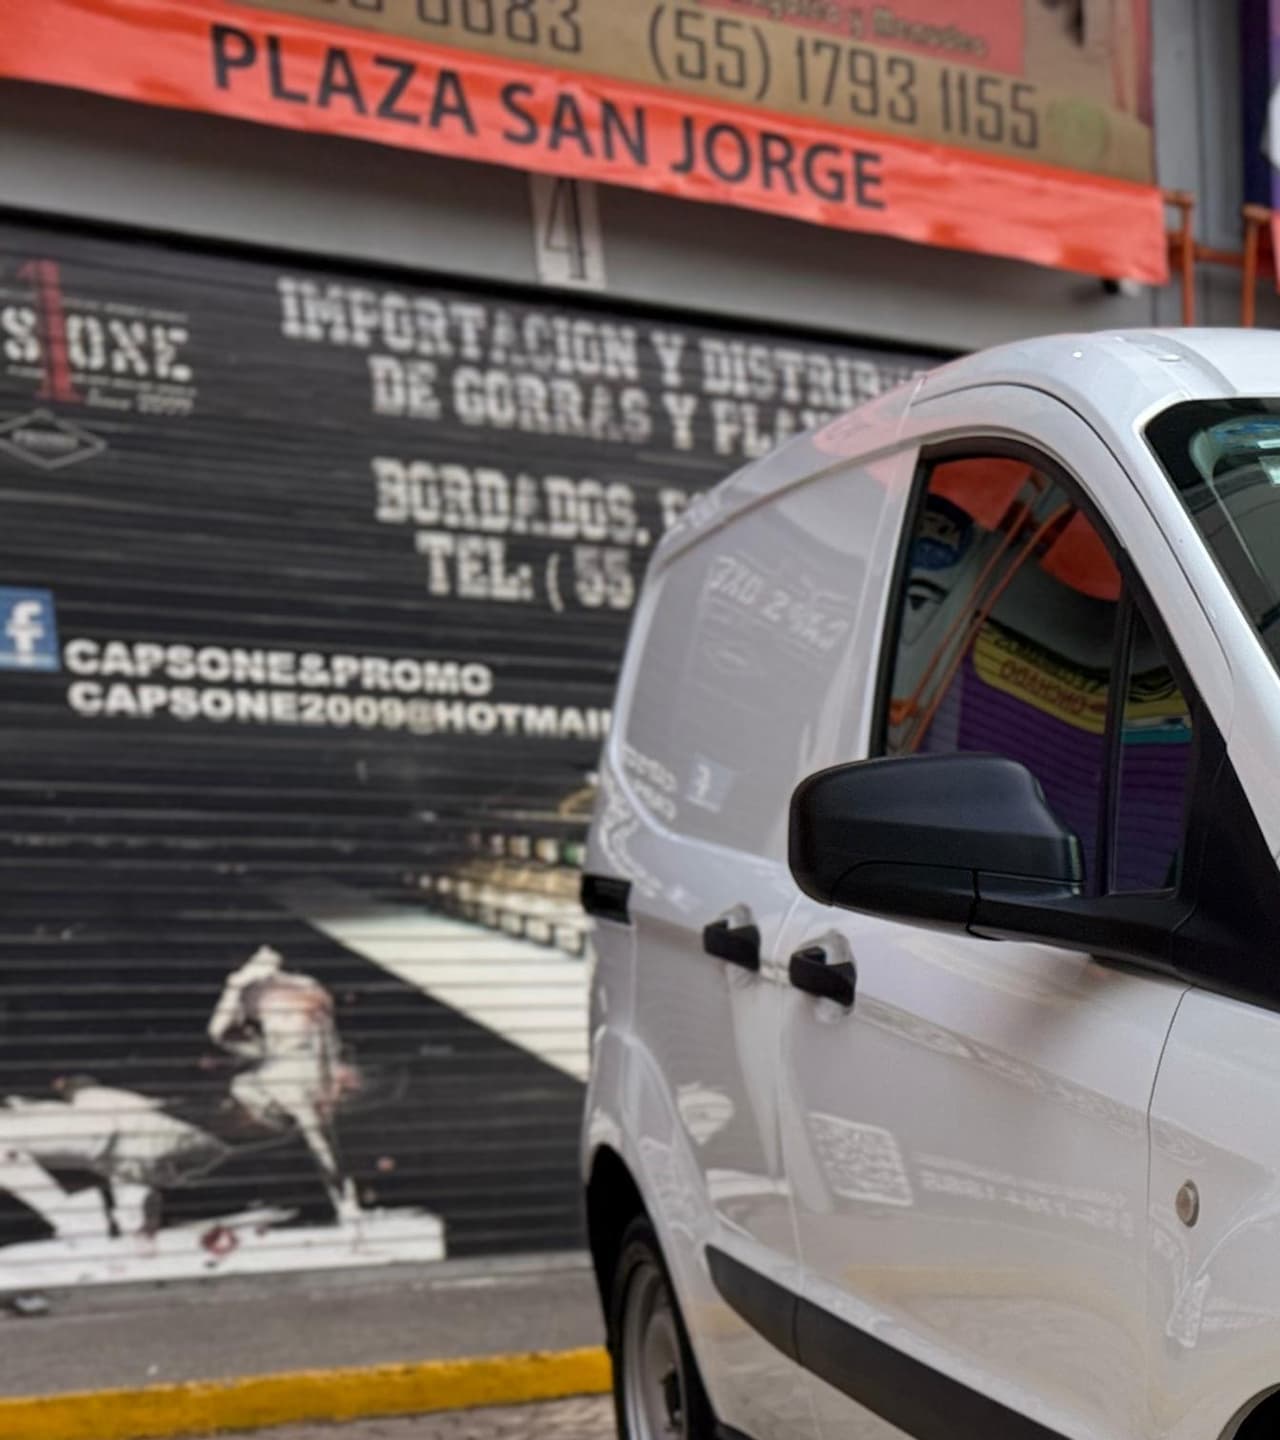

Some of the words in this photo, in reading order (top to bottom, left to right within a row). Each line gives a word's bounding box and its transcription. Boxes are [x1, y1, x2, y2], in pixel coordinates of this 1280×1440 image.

[212, 23, 477, 137] PLAZA
[502, 82, 649, 167] SAN
[672, 117, 887, 210] JORGE
[650, 4, 771, 100] (55)
[796, 37, 918, 125] 1793
[939, 73, 1040, 149] 1155
[277, 275, 639, 382] IMPORTACION
[650, 330, 690, 388] Y
[368, 355, 441, 418] DE
[452, 367, 652, 445] GORRAS
[660, 390, 698, 451] Y
[415, 534, 534, 601] TEL:
[63, 637, 494, 697] CAPSONE&PROMO
